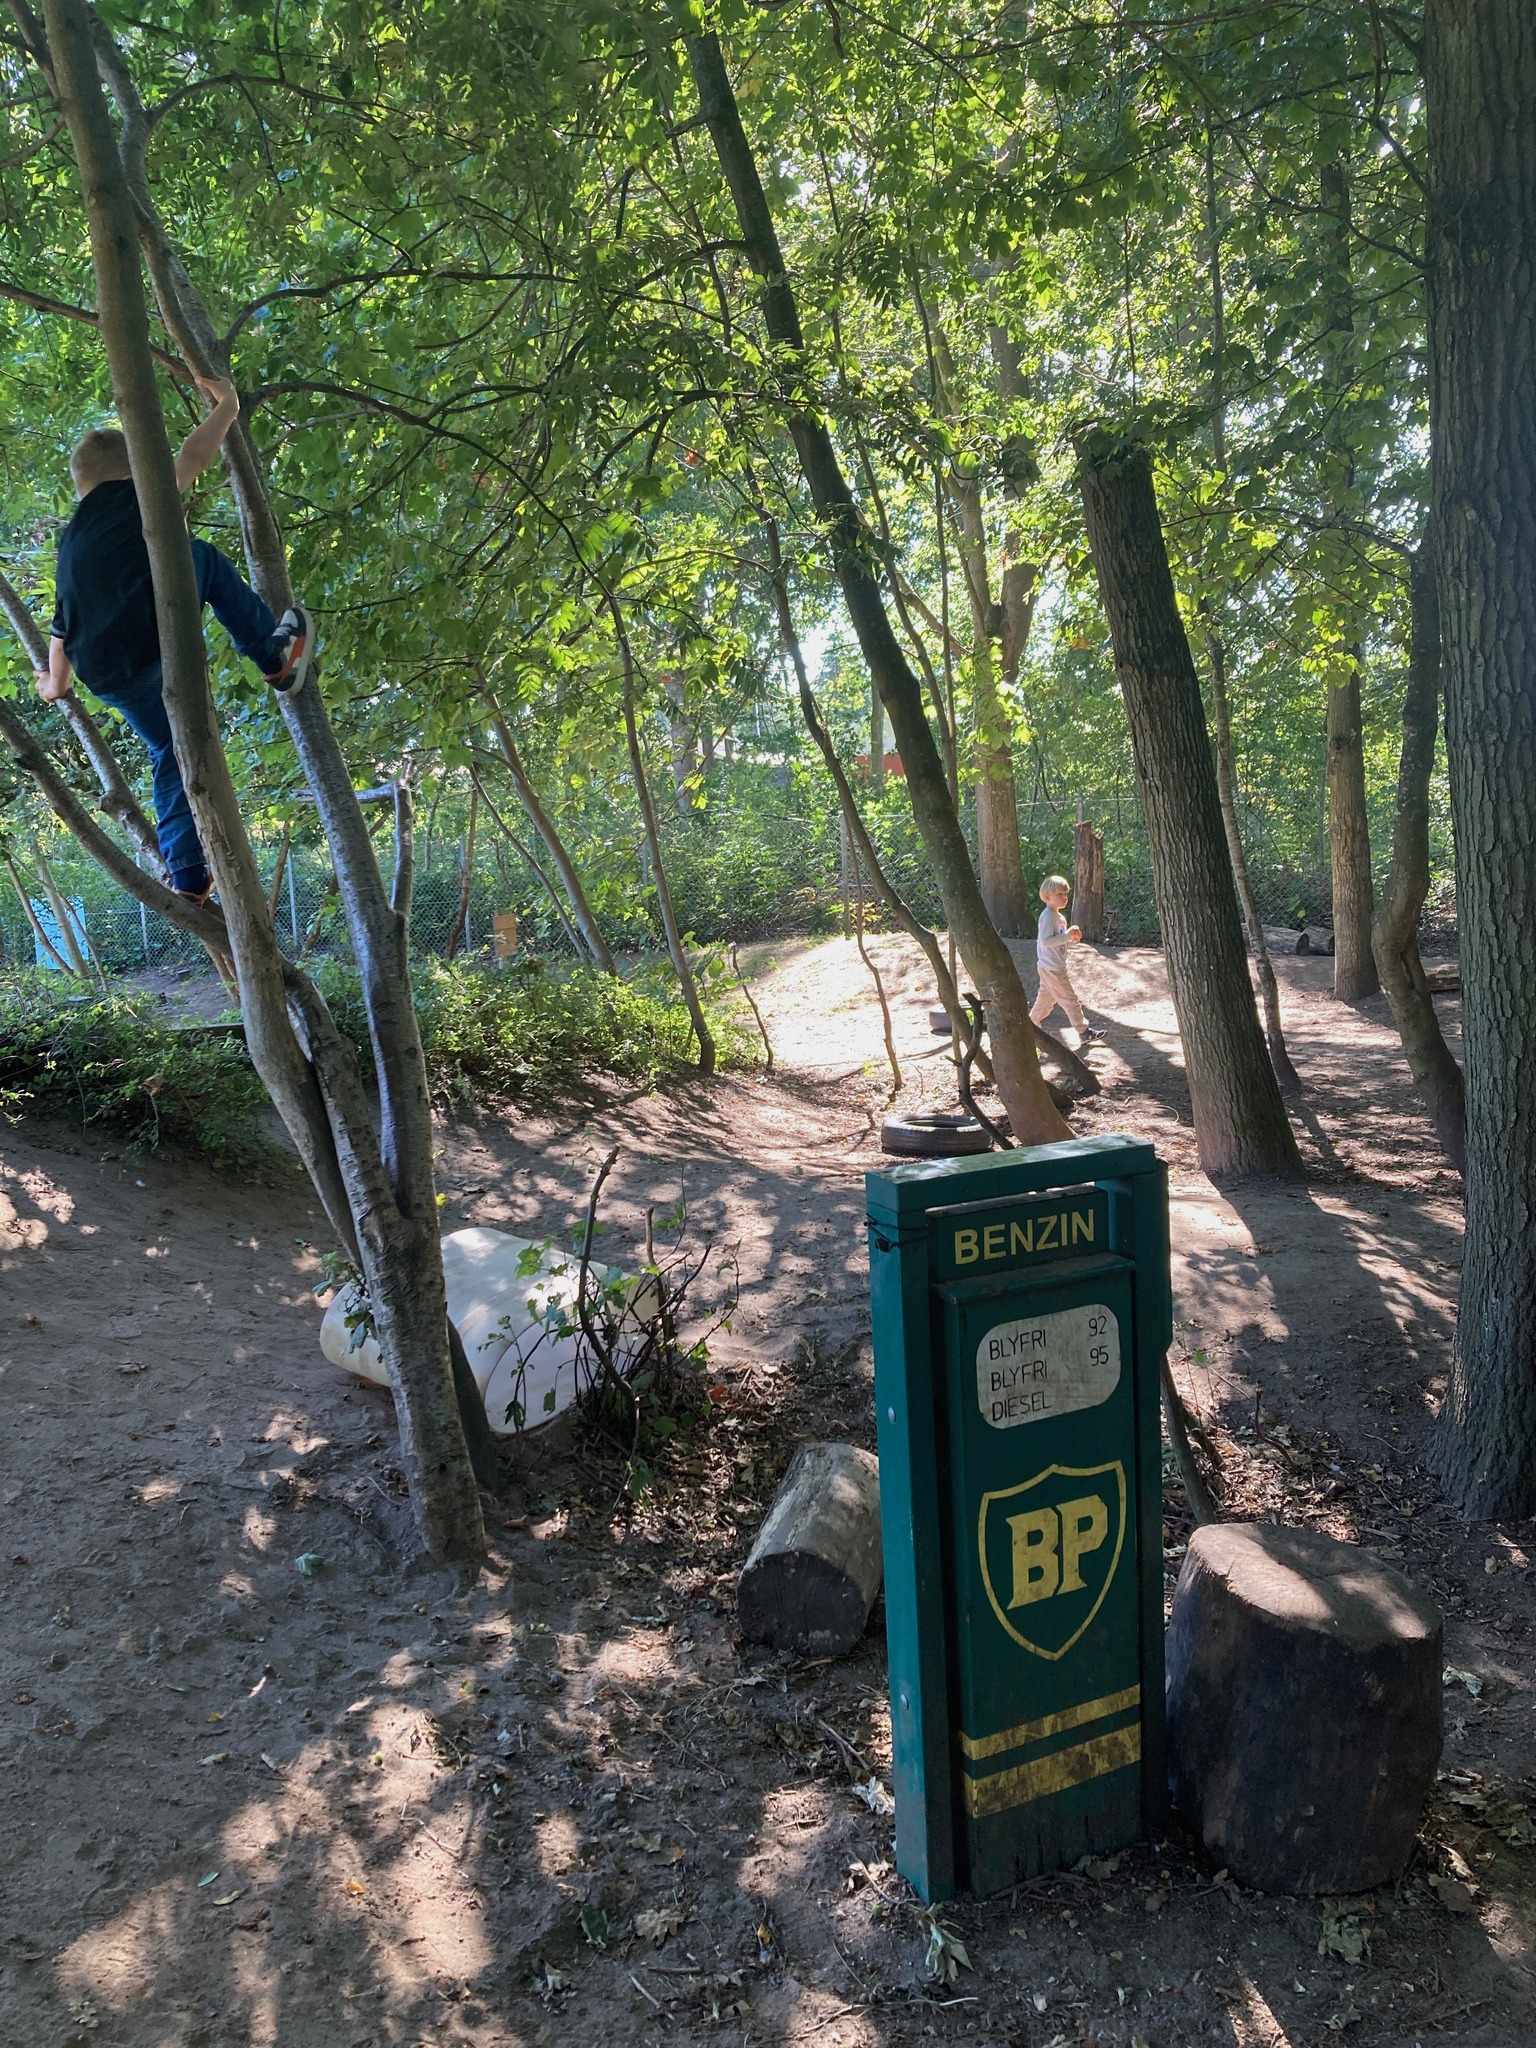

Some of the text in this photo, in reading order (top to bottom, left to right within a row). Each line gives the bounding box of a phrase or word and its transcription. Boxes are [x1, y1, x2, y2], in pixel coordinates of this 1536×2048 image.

[955, 1208, 1095, 1265] BENZIN
[989, 1315, 1107, 1361] BLYFRI 92
[991, 1345, 1109, 1392] BLYFRI 95
[992, 1391, 1051, 1422] DIESEL
[1005, 1494, 1108, 1610] BP
